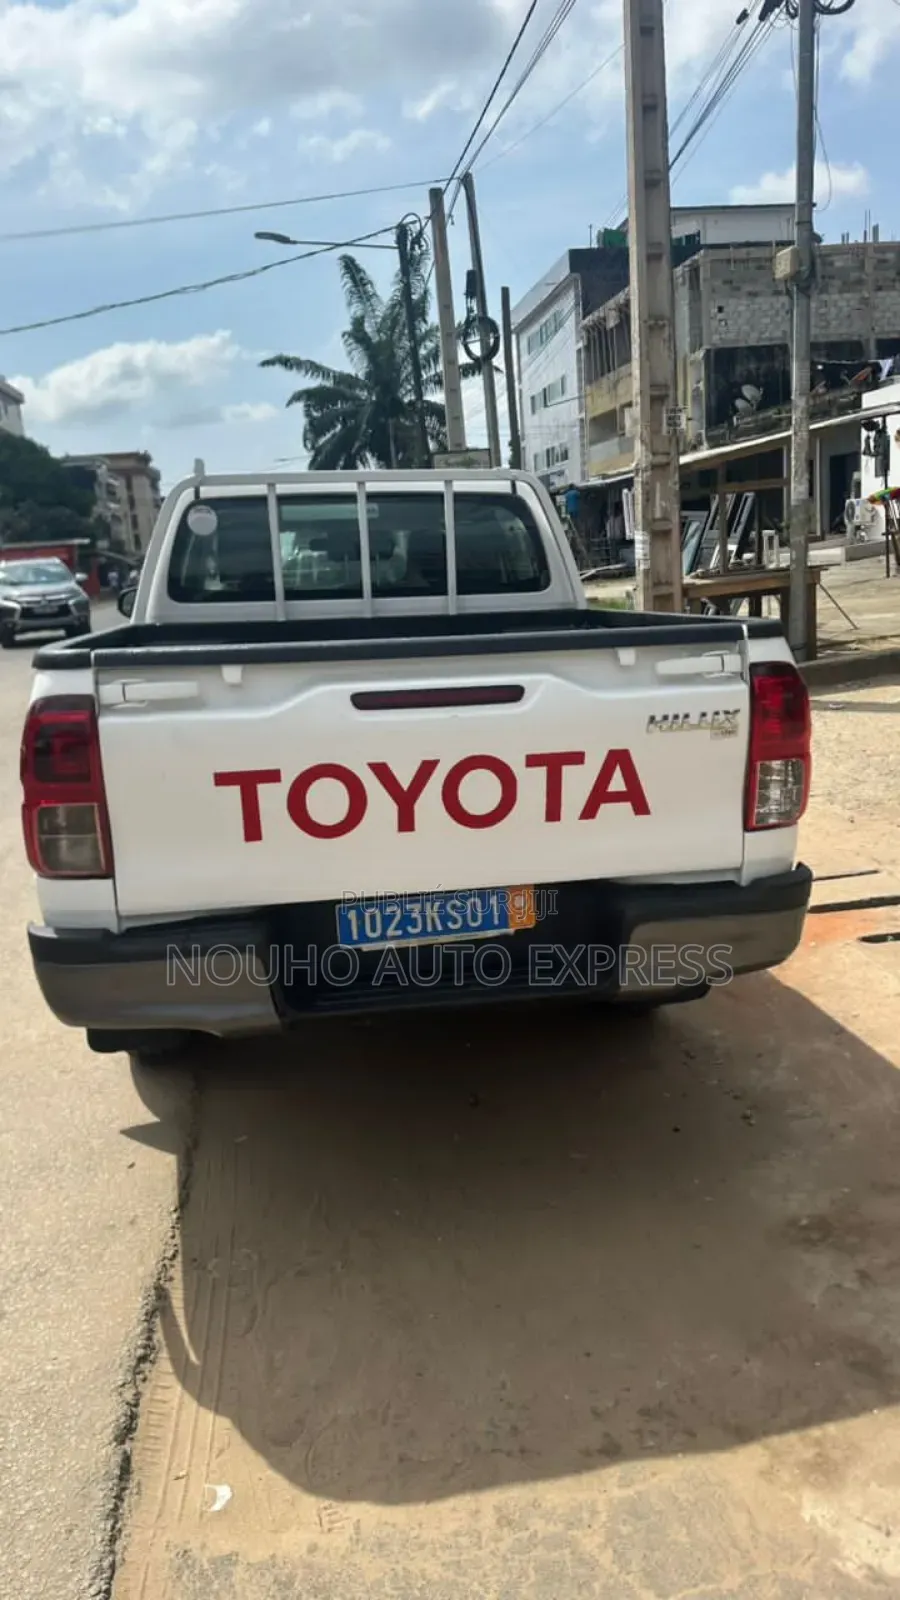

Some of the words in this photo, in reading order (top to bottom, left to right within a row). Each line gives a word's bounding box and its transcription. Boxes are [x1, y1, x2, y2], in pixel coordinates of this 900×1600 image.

[646, 708, 741, 734] HILUX
[213, 748, 651, 842] TOYOTA
[347, 895, 500, 940] 1023KS01
